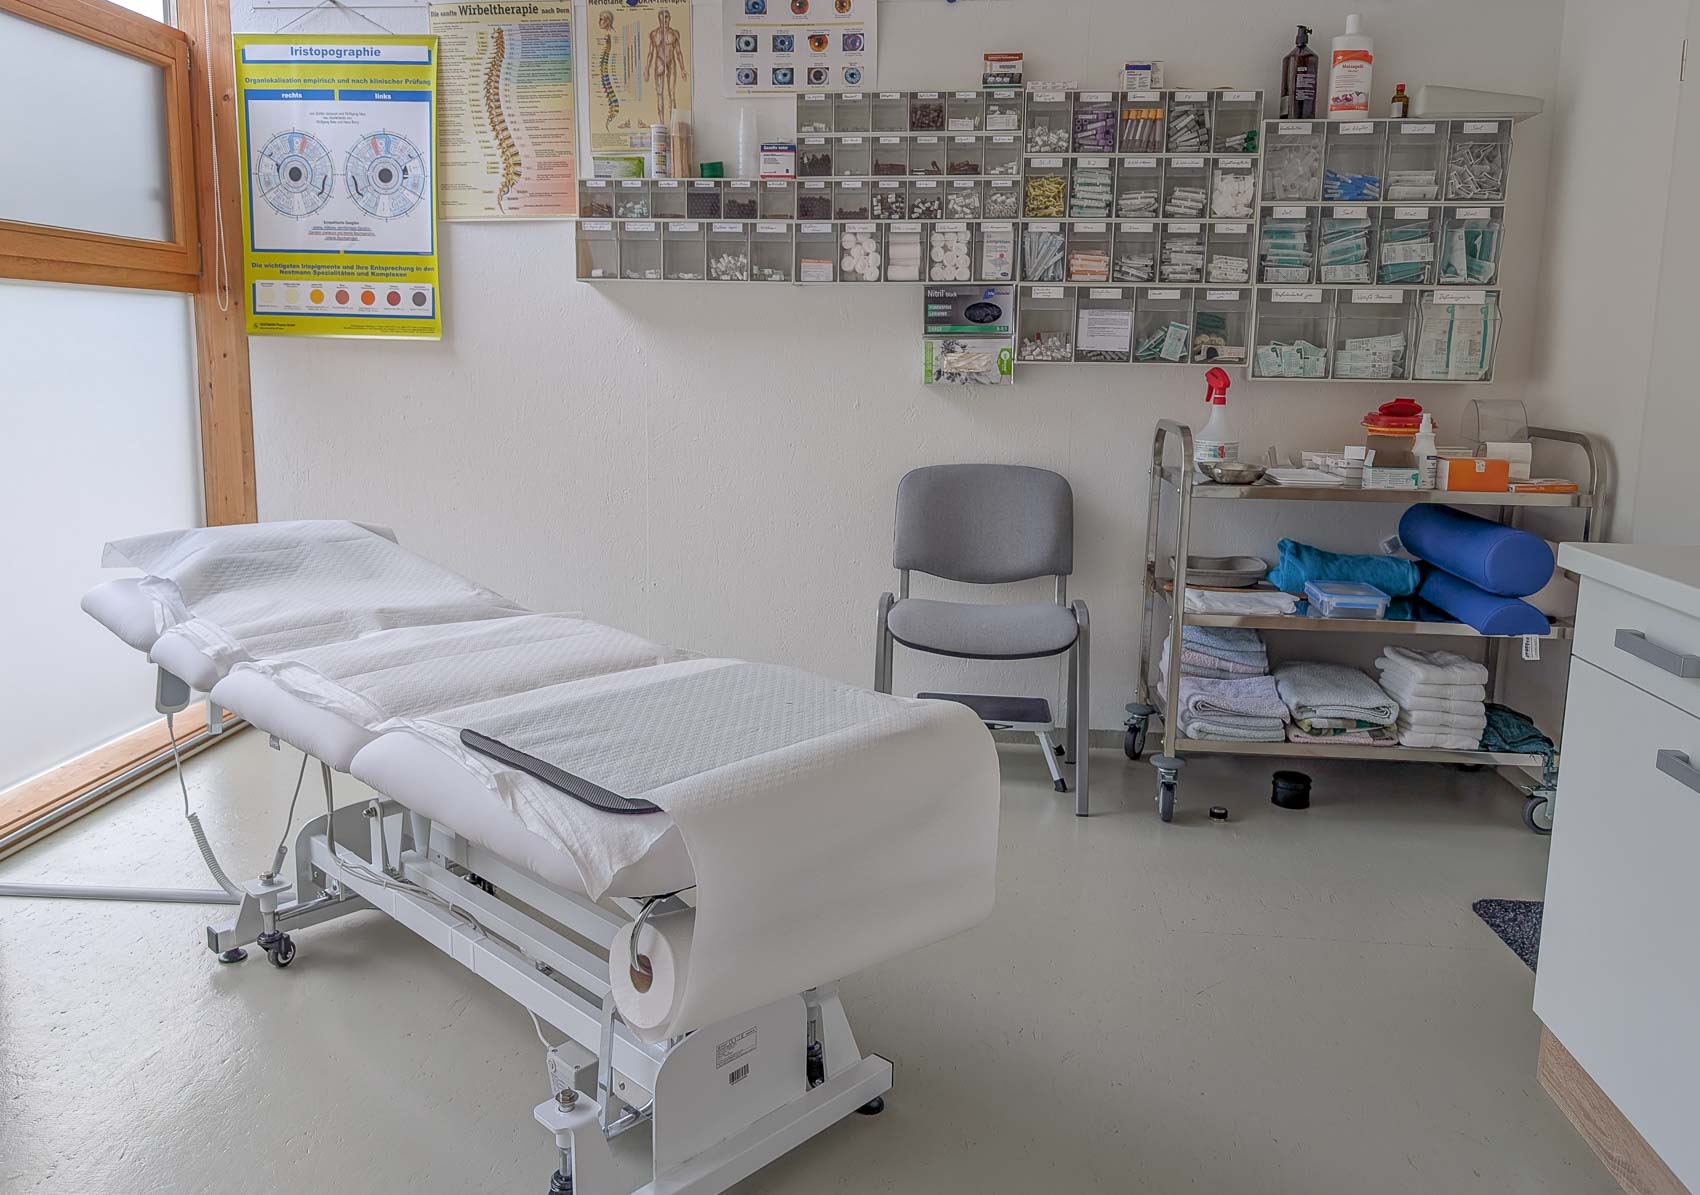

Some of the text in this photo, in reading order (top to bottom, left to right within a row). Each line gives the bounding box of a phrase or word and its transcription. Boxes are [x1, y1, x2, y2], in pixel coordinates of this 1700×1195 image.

[458, 4, 539, 16] Wirbeltherapie
[290, 46, 381, 59] Iristopographie
[244, 77, 302, 85] Organlokalisation
[370, 264, 415, 272] Entsprechung
